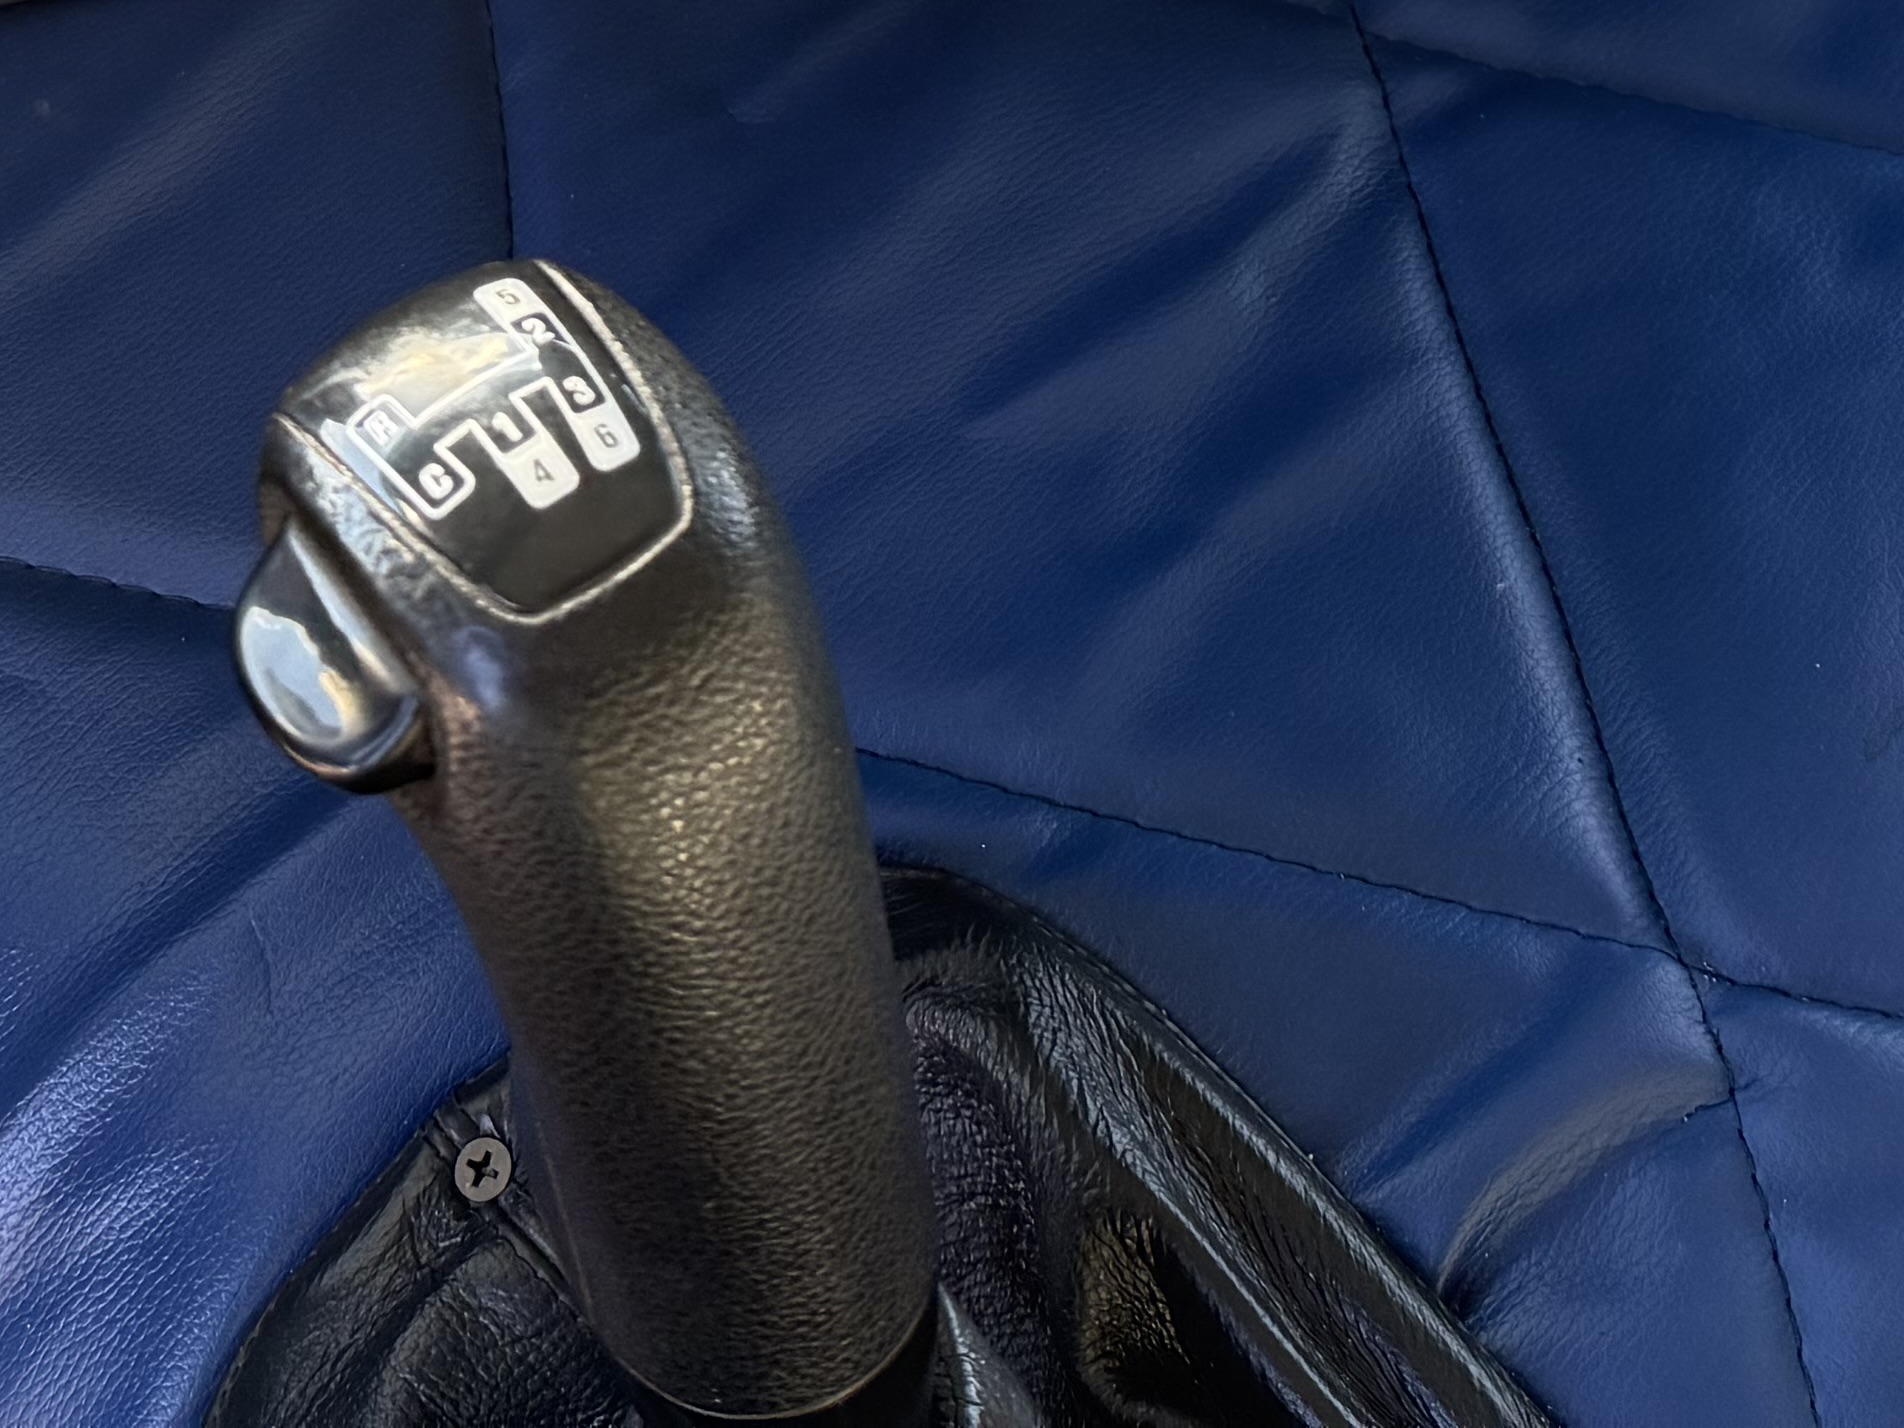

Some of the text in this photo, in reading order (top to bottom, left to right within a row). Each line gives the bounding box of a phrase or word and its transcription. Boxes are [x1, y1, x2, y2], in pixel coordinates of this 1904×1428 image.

[495, 288, 521, 305] 5
[521, 317, 556, 345] 2
[562, 375, 596, 406] 3
[362, 410, 399, 443] R
[491, 411, 523, 442] 1
[594, 423, 619, 448] 6
[419, 462, 454, 499] C
[532, 458, 556, 482] 4
